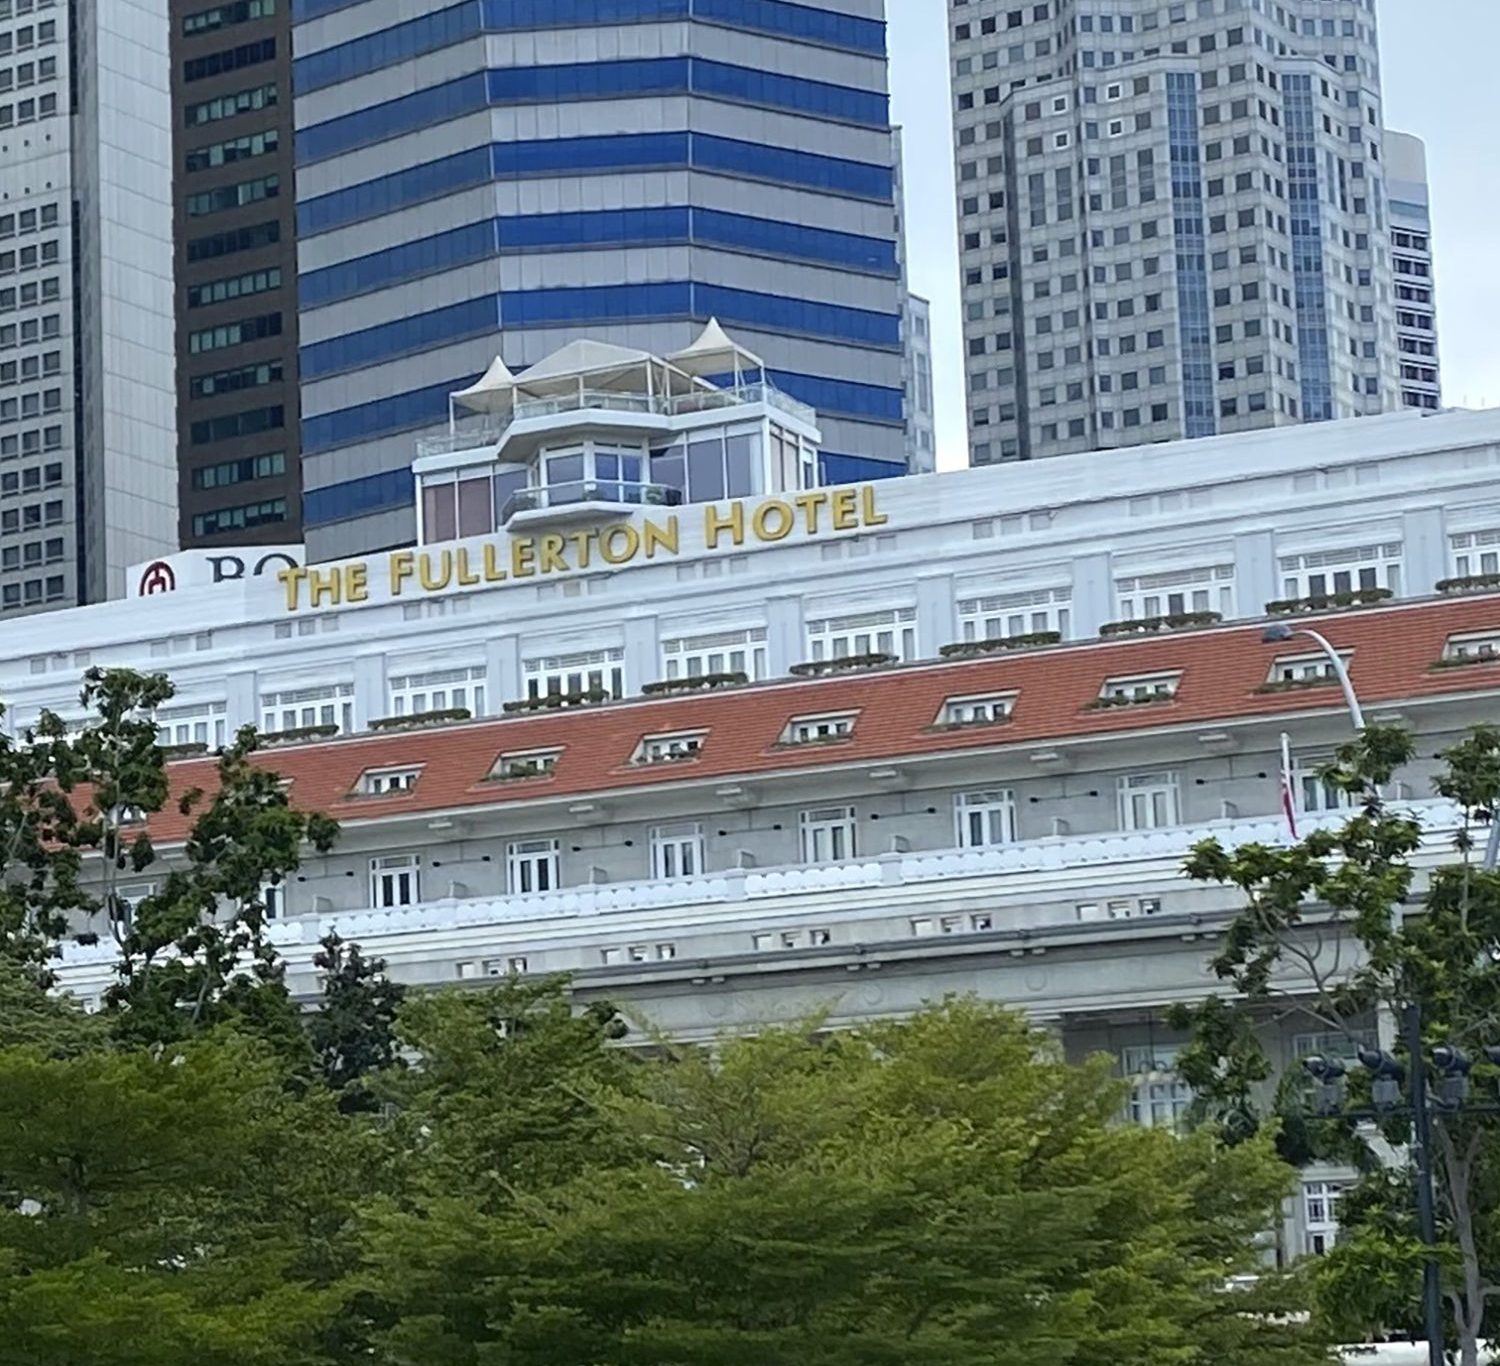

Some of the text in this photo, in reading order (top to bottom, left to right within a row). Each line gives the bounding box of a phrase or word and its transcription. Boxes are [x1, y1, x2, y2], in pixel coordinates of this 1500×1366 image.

[278, 485, 889, 611] THE FULLERTON HOTEL
